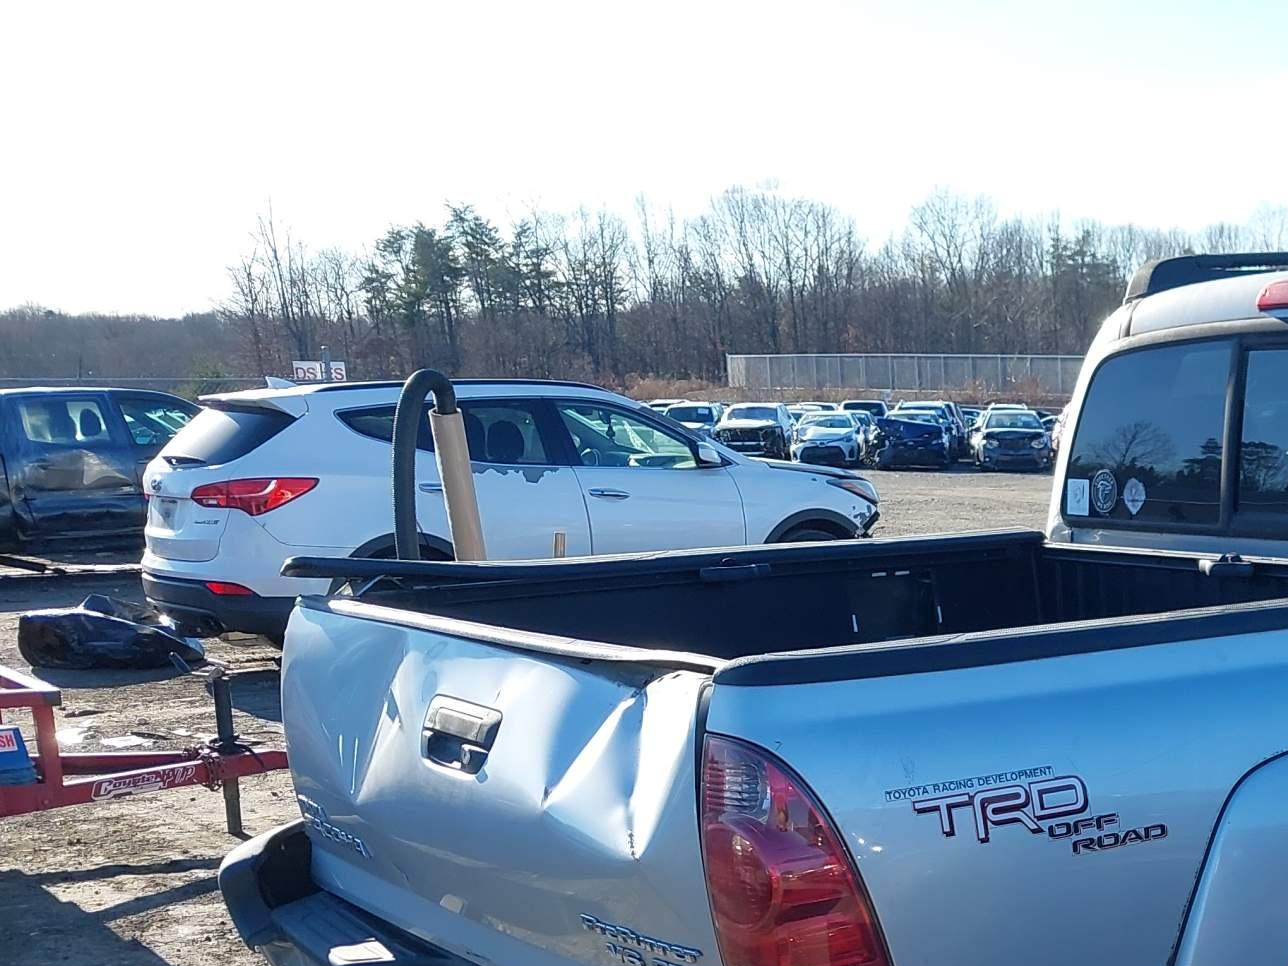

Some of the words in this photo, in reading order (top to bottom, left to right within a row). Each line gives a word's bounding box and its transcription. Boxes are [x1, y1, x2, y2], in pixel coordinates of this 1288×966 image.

[885, 784, 930, 802] TOYOTA
[932, 778, 975, 795] RACING
[977, 766, 1054, 787] DEVELOPMENT
[912, 774, 1090, 844] TRD
[1047, 813, 1120, 839] OFF
[1071, 823, 1168, 855] ROAD
